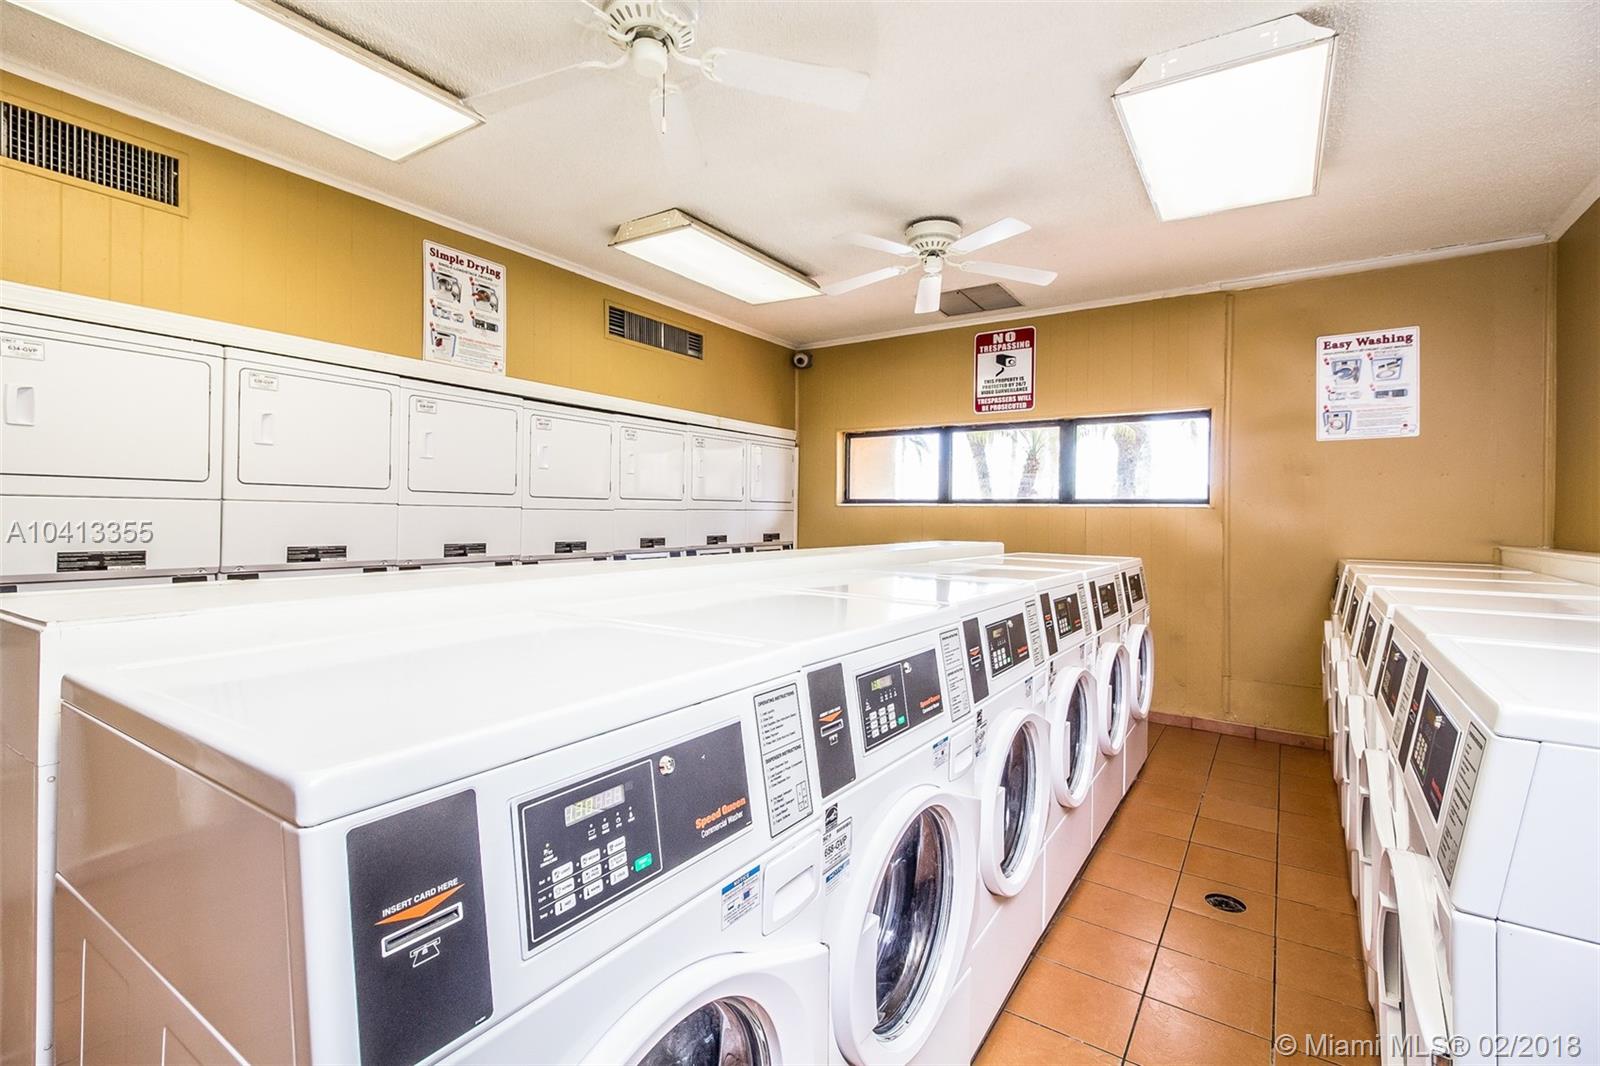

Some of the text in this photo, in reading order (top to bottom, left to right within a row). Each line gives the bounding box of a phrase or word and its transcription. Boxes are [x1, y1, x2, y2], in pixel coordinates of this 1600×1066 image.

[429, 247, 465, 266] Simple
[466, 259, 502, 280] Drying
[992, 331, 1016, 344] NO
[1323, 340, 1353, 351] Easy
[1356, 334, 1414, 347] Washing
[979, 340, 1031, 353] TRESPASSING
[977, 394, 1032, 405] TRESPASSERS WILL
[990, 402, 1028, 411] PROSECUTED
[695, 797, 747, 829] Speed Queen
[701, 818, 728, 839] Commercial
[381, 877, 459, 918] INSERT CARD HERE
